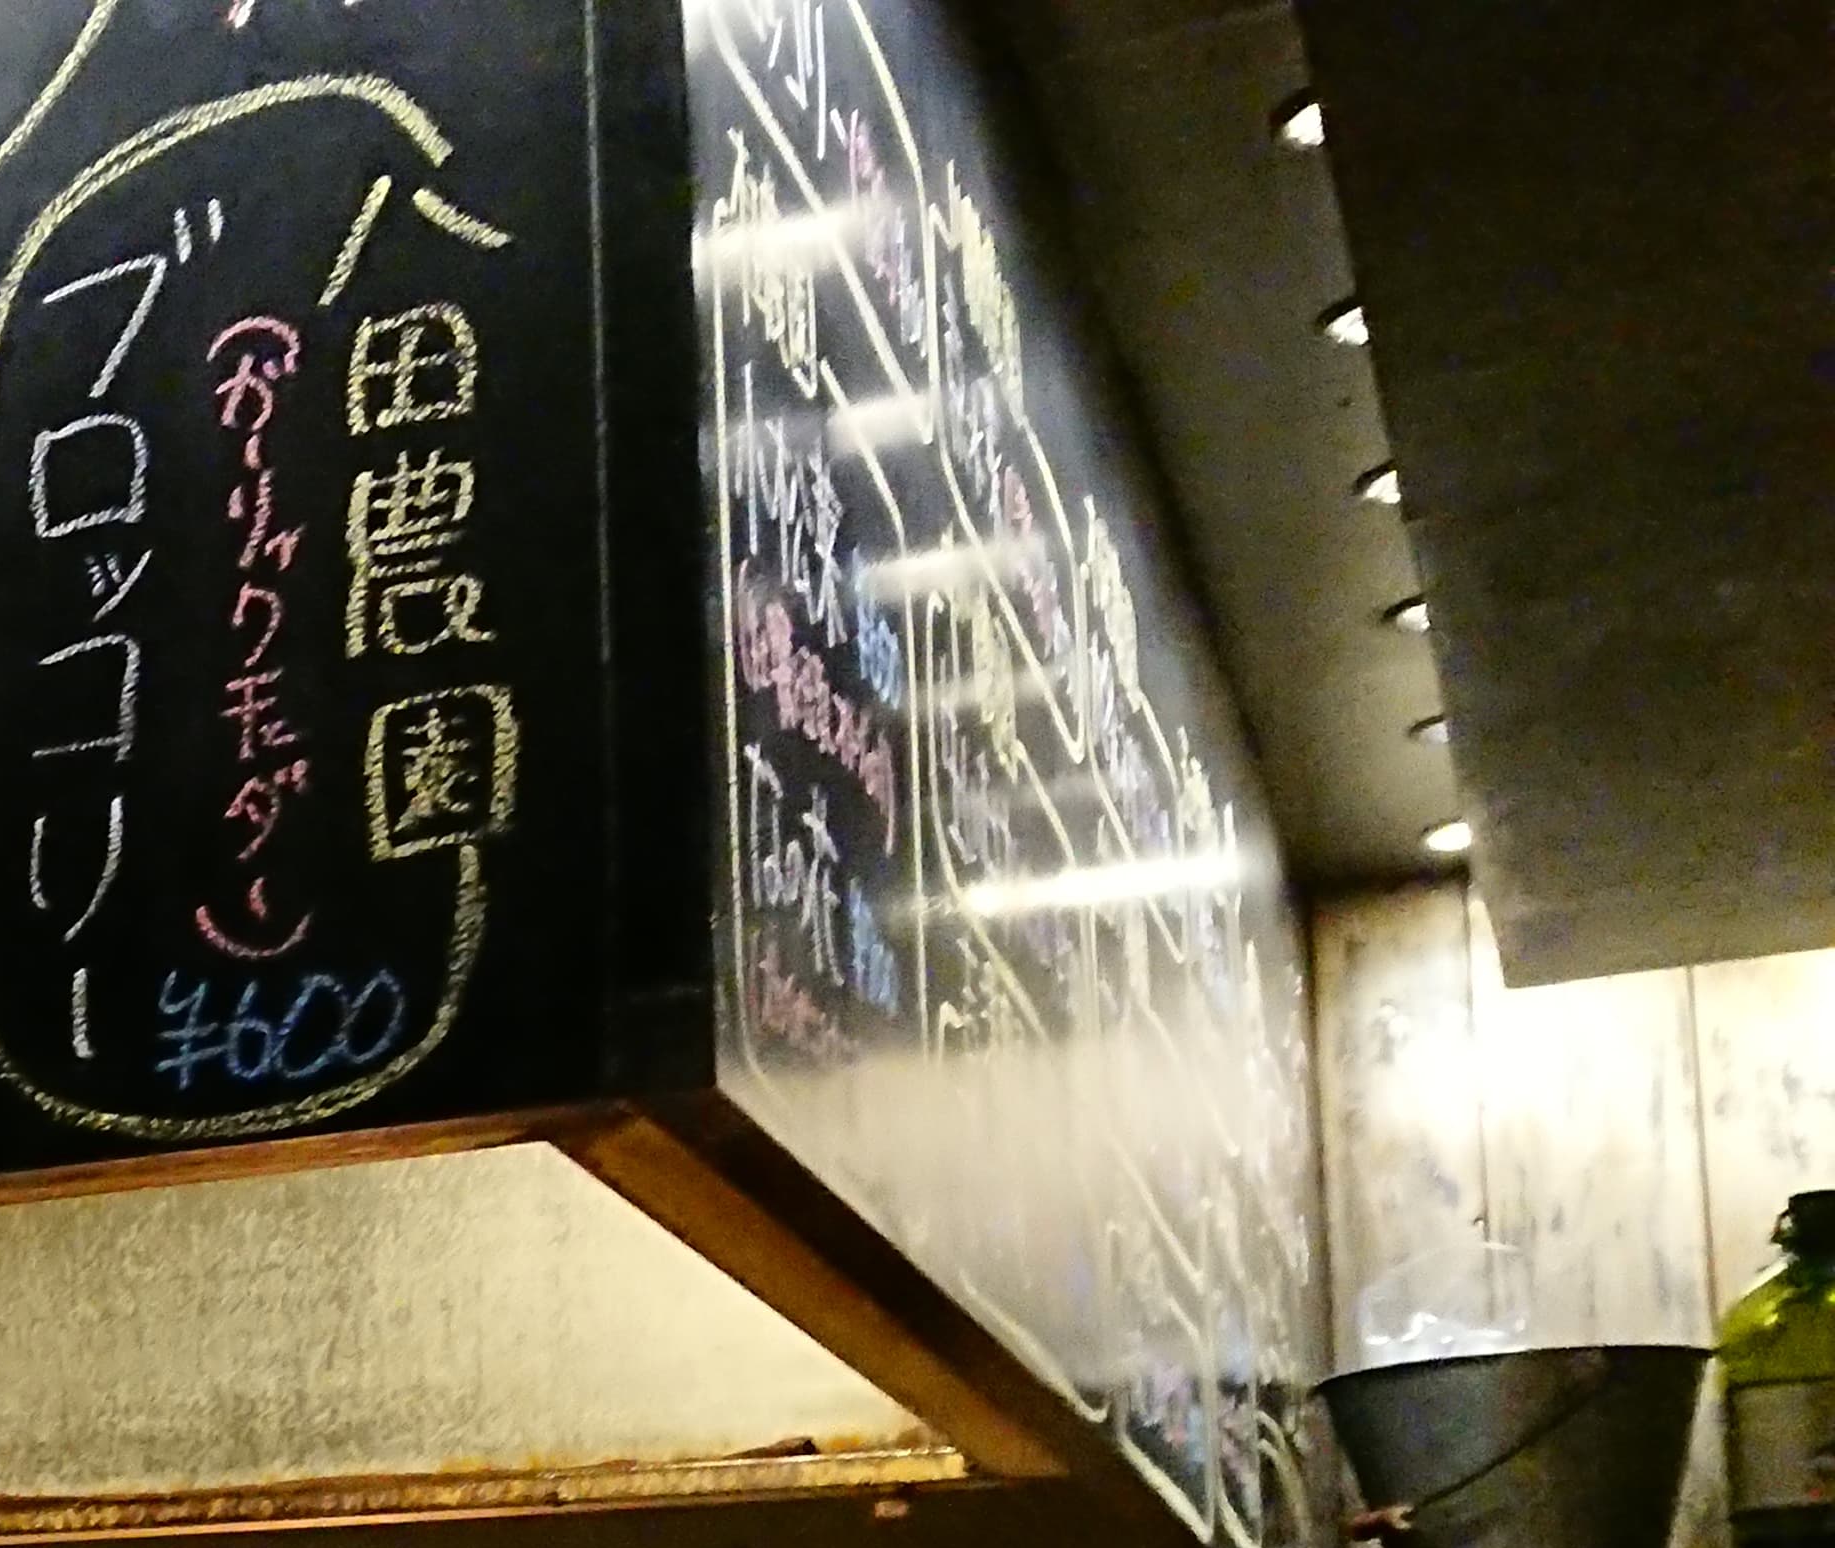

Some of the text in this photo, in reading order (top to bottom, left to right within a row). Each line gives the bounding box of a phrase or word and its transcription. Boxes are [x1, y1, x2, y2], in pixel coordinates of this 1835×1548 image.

[29, 198, 224, 1060] ブロッコリー
[315, 174, 521, 862] 八田農園
[155, 966, 406, 1091] ¥600
